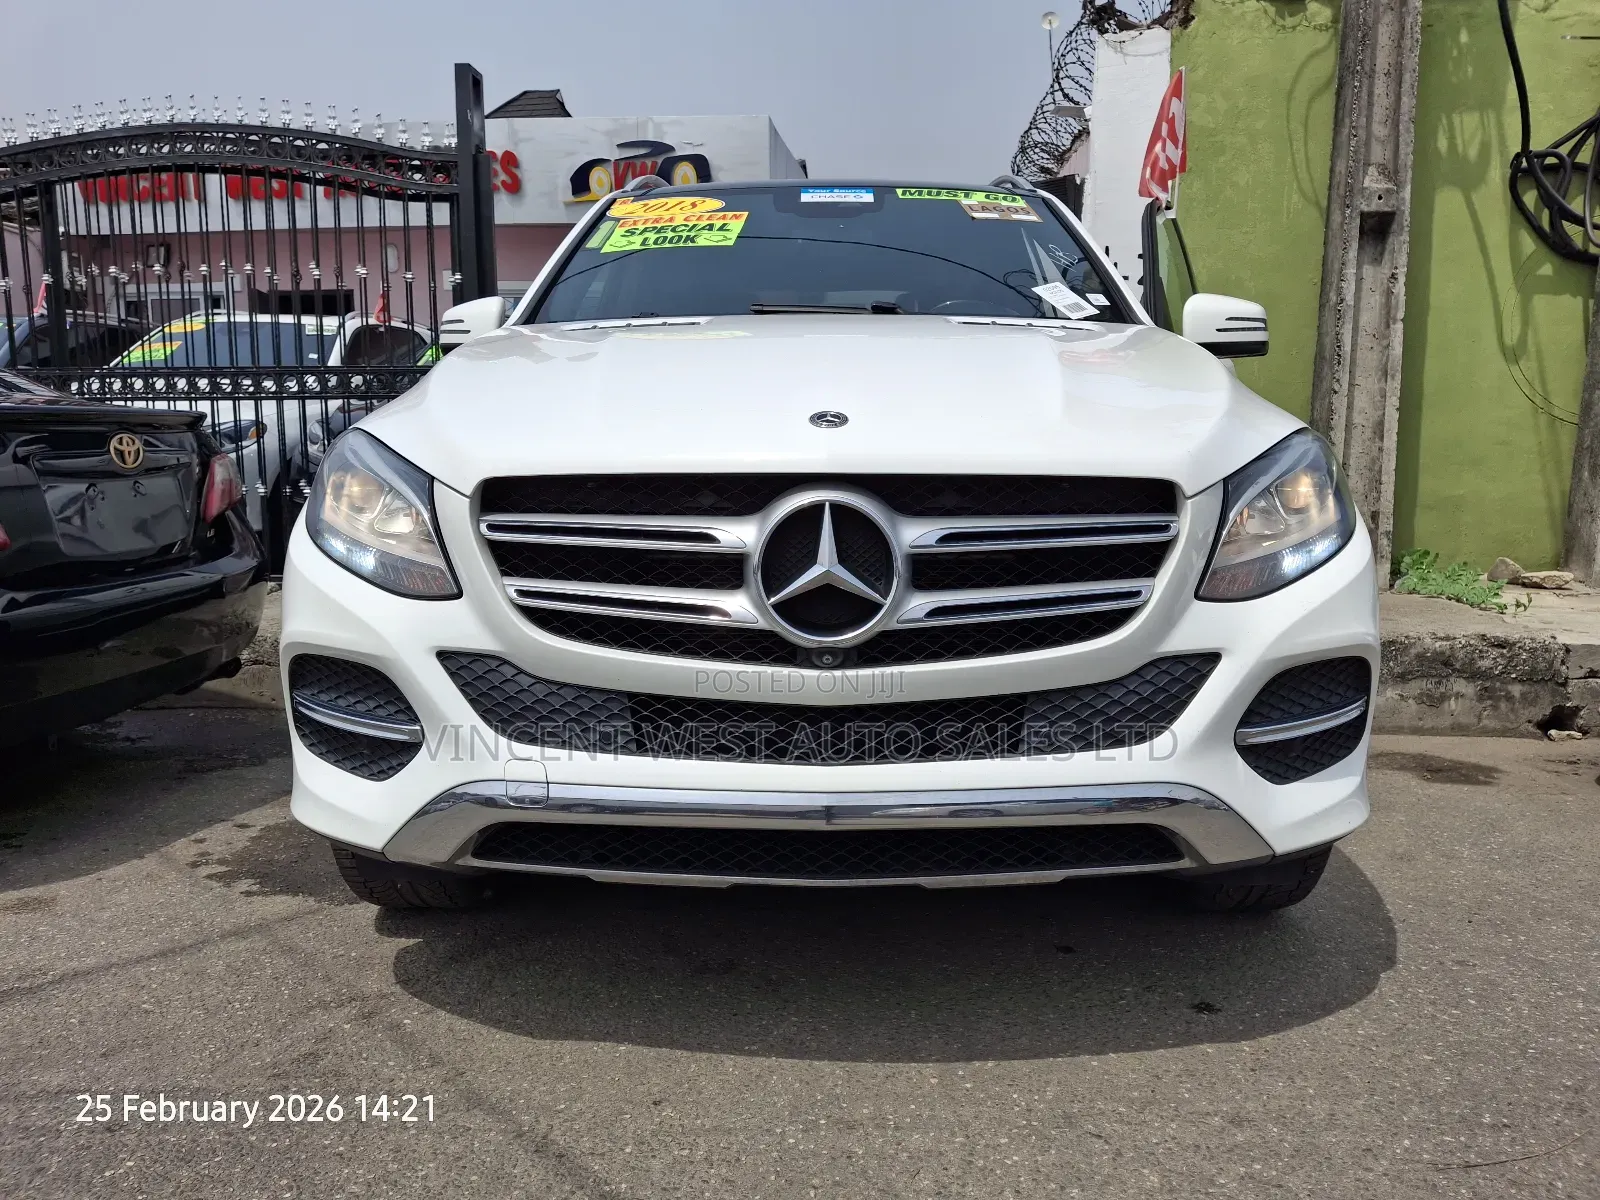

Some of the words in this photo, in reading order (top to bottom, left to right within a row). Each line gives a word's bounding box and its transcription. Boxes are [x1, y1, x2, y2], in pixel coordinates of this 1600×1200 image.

[900, 189, 975, 199] MUST
[984, 193, 1020, 203] GO
[623, 200, 706, 215] 2018
[967, 204, 1032, 216] LAGOS
[619, 215, 676, 228] EXTRA
[683, 213, 744, 223] CLEAN
[620, 222, 733, 238] SPECIAL
[639, 234, 701, 248] LOOK
